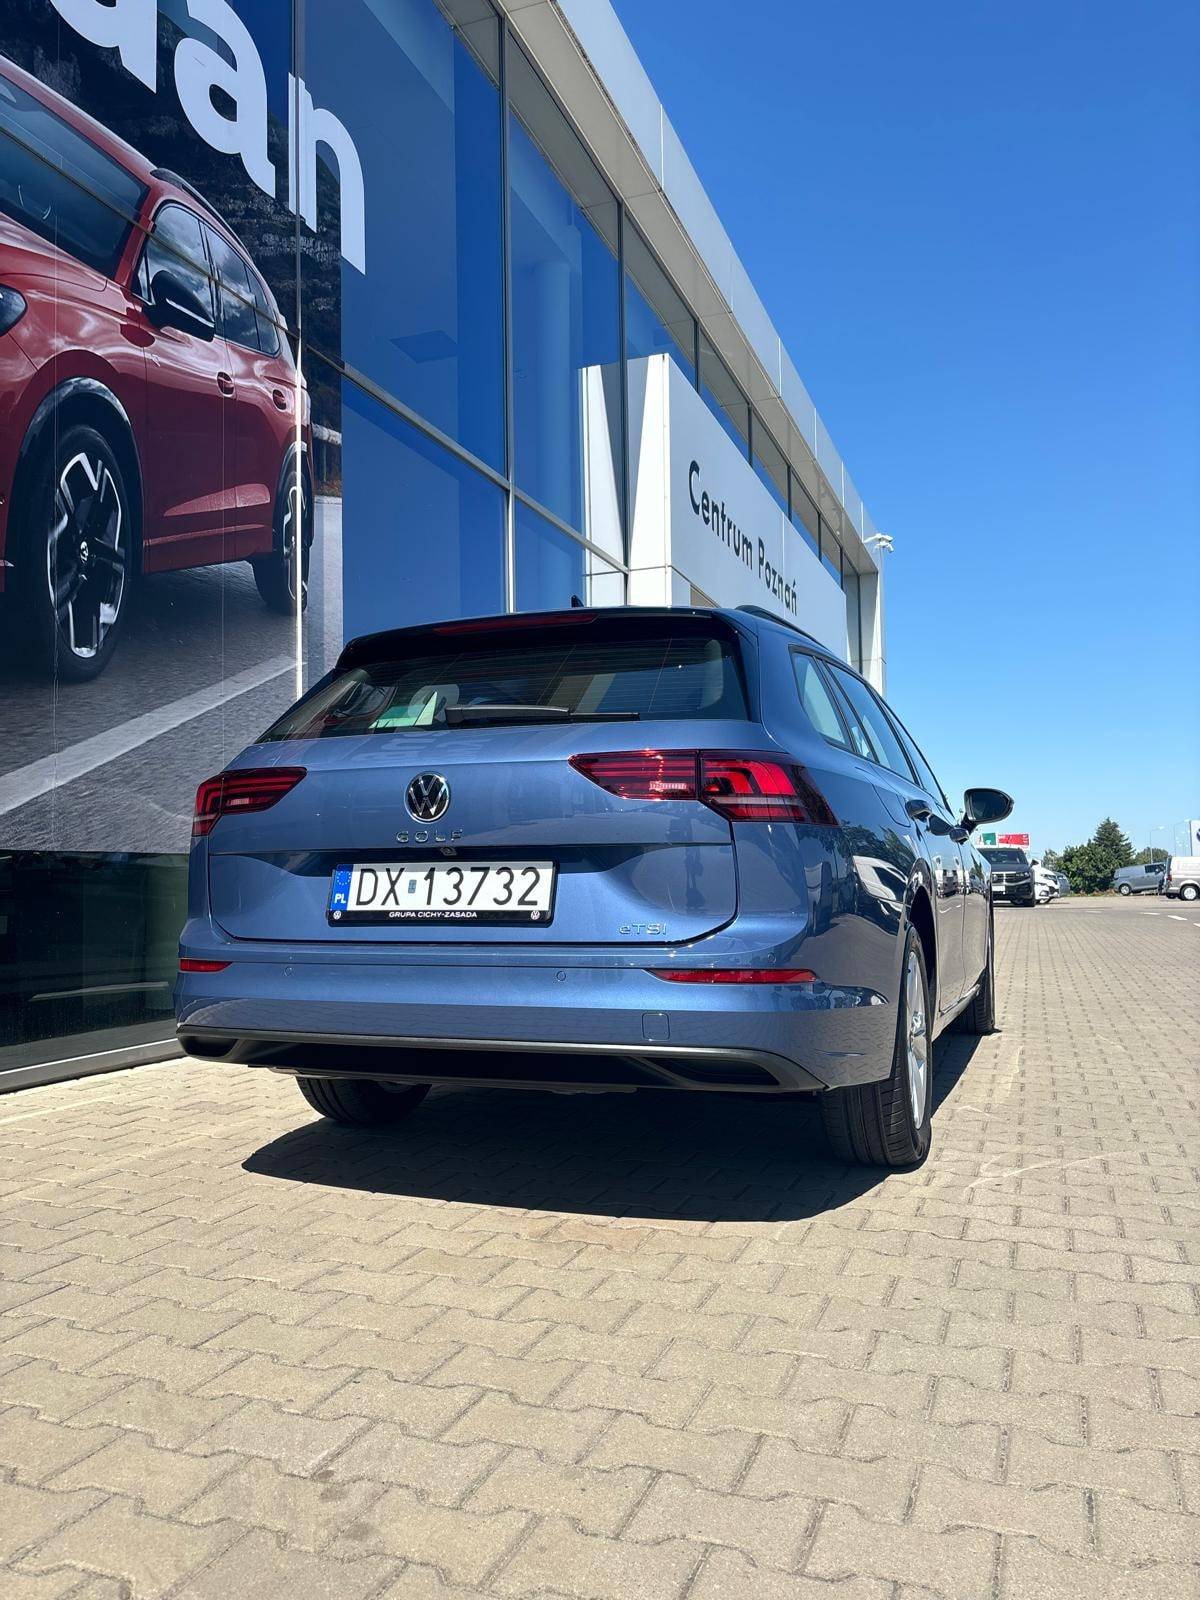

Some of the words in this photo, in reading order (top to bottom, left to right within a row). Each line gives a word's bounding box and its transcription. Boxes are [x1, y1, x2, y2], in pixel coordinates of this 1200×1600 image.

[688, 459, 753, 570] Centrum
[758, 536, 797, 616] Poznań
[396, 829, 463, 843] GOLF
[355, 867, 406, 906] DX
[423, 866, 541, 906] 13732
[334, 894, 347, 904] PL
[618, 922, 667, 935] eTSI
